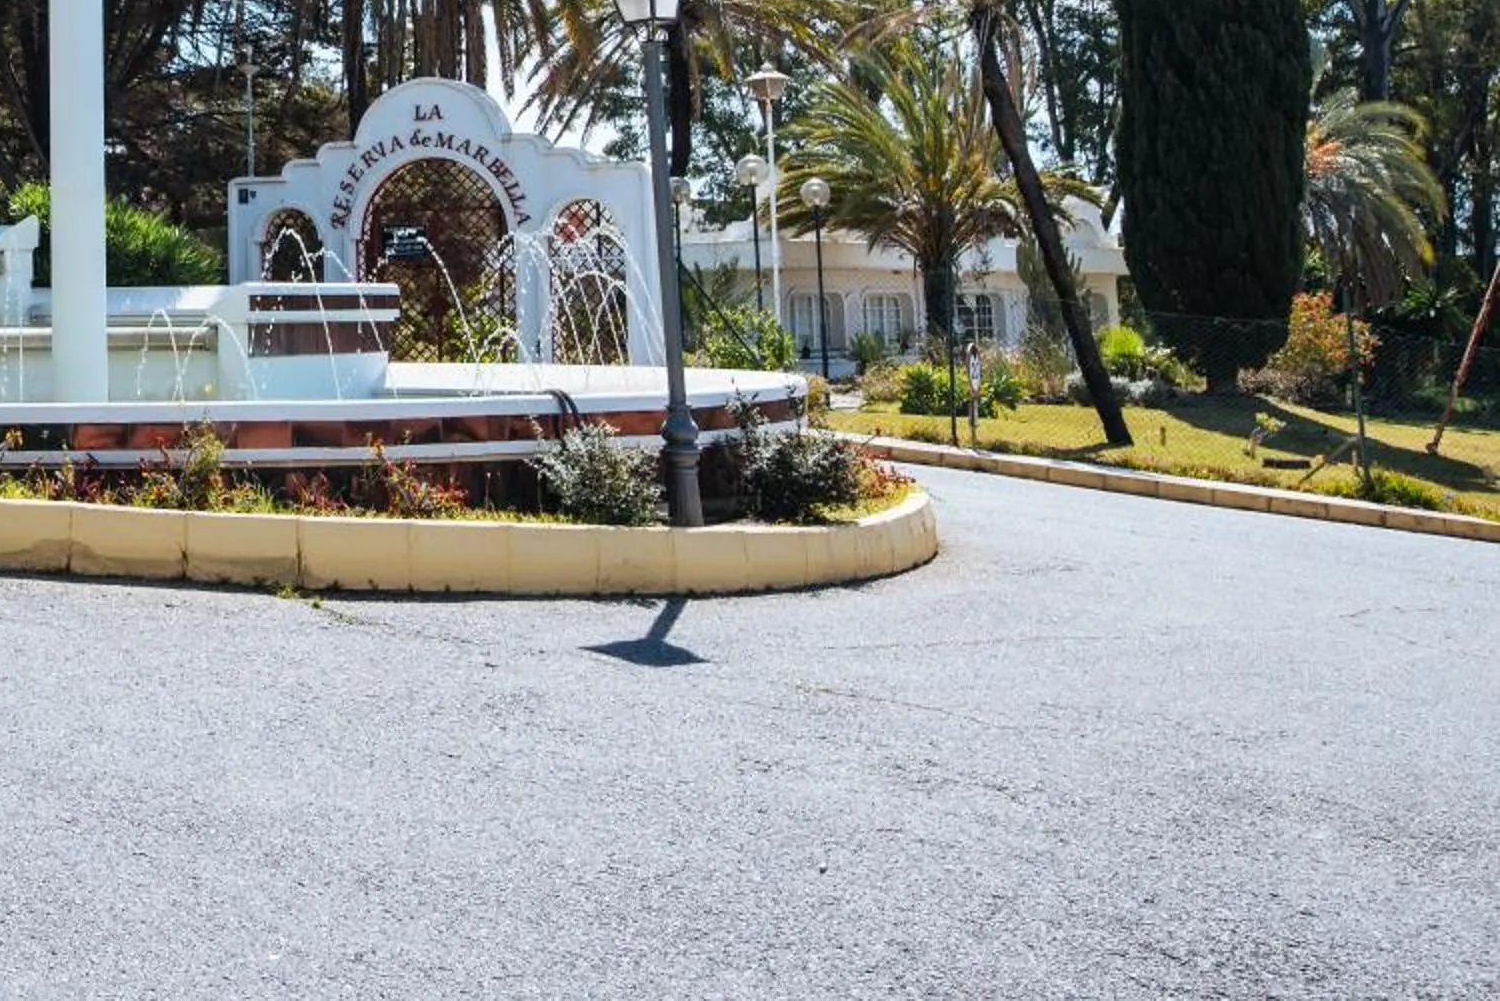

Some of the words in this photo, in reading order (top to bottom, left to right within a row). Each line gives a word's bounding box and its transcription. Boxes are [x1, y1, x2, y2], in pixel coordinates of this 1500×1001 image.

[413, 103, 444, 122] LA
[329, 134, 405, 230] RESERVA
[409, 128, 432, 148] de
[434, 130, 532, 227] MARBELLA
